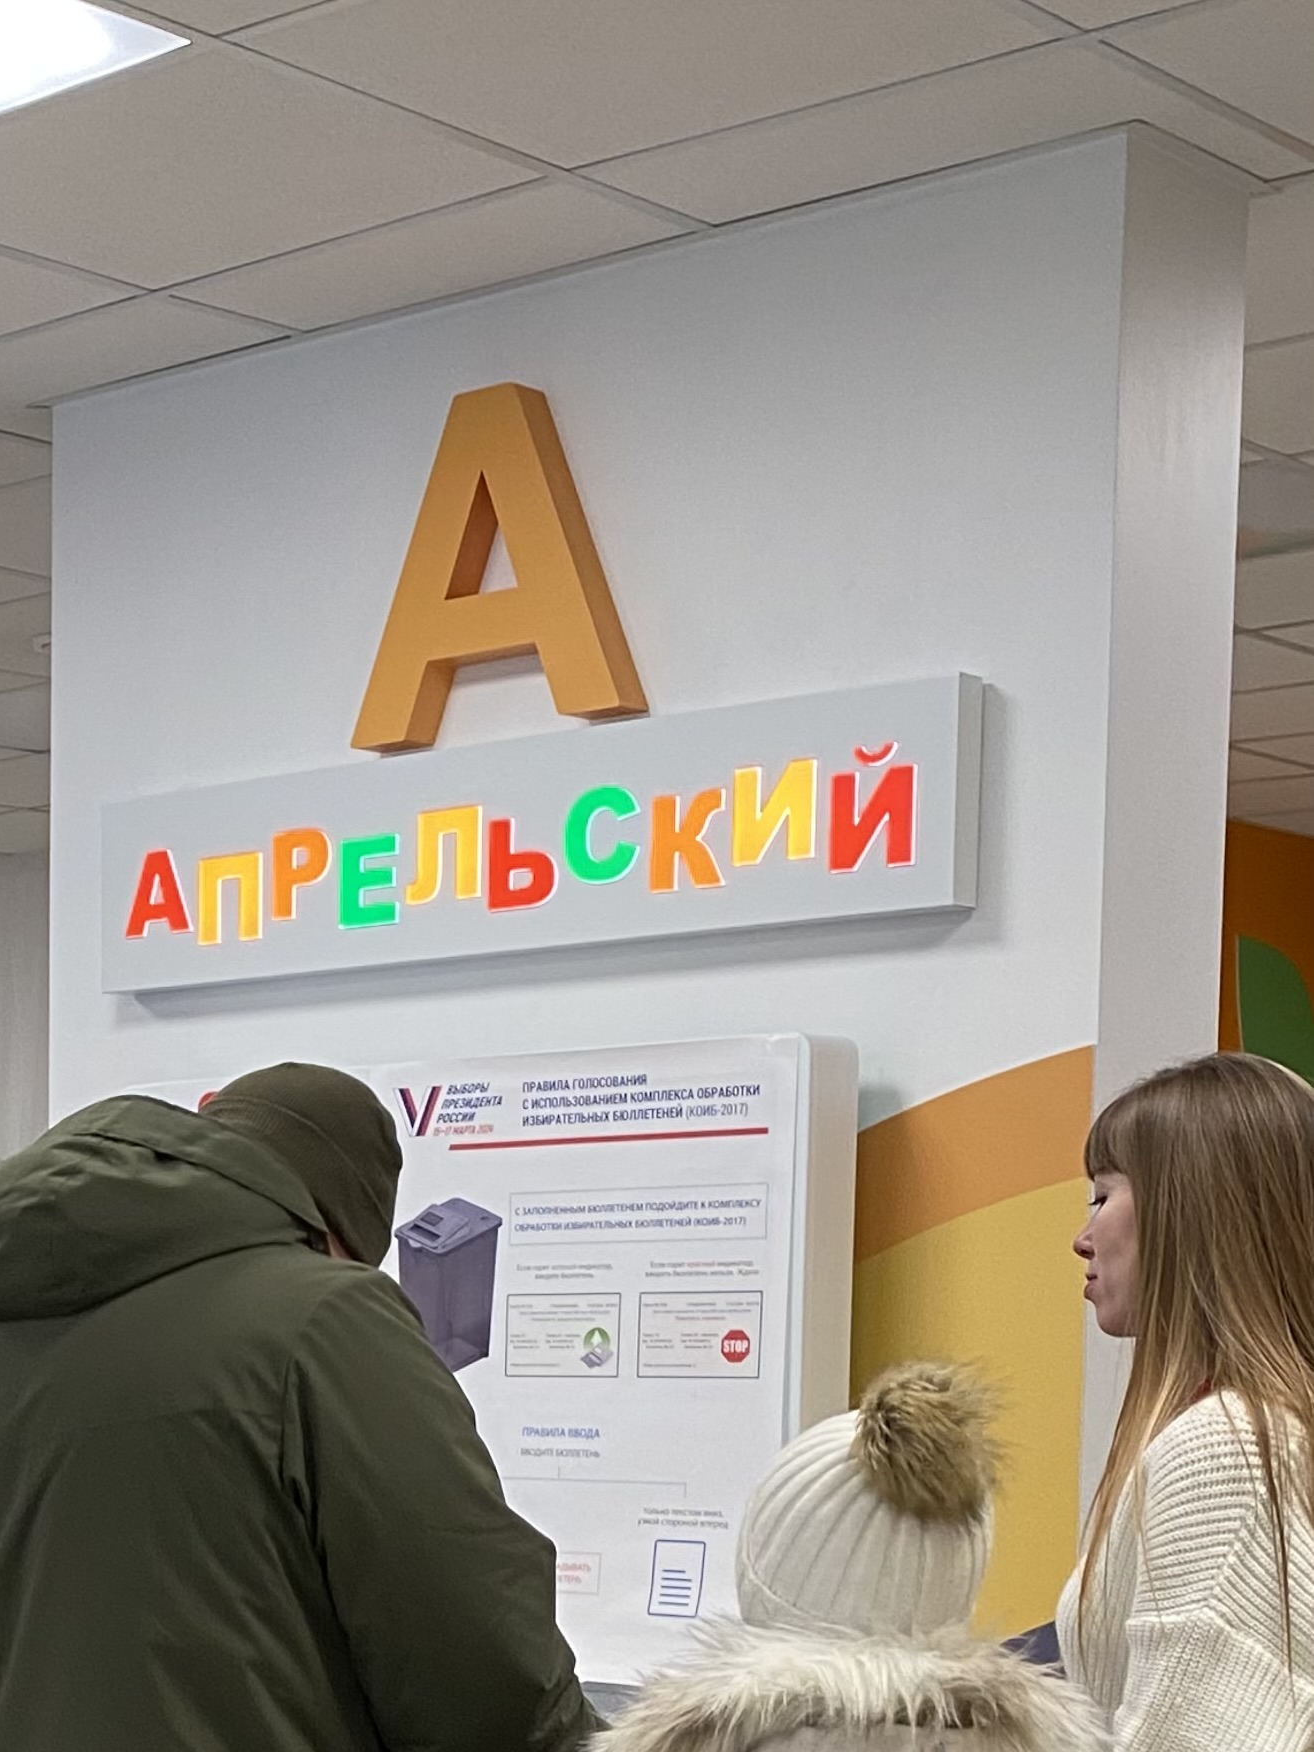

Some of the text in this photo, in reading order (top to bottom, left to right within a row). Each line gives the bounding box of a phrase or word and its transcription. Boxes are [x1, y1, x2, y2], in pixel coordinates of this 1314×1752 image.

[351, 381, 648, 753] А
[124, 742, 919, 947] АПРЕЛЬСКИЙ
[446, 1082, 490, 1095] ВЫБОРЫ
[522, 1073, 648, 1093] ПРАВИЛА ГОЛОСОВАНИЯ
[441, 1095, 503, 1110] ПРЕЗИДЕНТА
[522, 1083, 761, 1110] С ИСПОЛЬЗОВАНИЕМ КОМПЛЕКСА ОБРАБОТКИ
[436, 1111, 476, 1124] РОССИИ
[522, 1102, 749, 1127] ИЗБИРАТЕЛЬНЫХ БЮЛЛЕТЕНЕЙ (КОИБ-2017)
[522, 1205, 586, 1216] ЗАПОЛНЕННЫМ
[587, 1203, 643, 1214] БЮЛЛЕТЕНЕМ
[646, 1200, 699, 1212] ПОДОЙДИТЕ
[700, 1201, 706, 1210] К
[707, 1199, 762, 1209] КОМПЛЕКСУ
[514, 1216, 747, 1232] ОБРАБОТКИ ИЗБИРАТЕЛЬНЫХ БЮЛЛЕТЕНЕЙ (КОИБ-2017)
[723, 1340, 749, 1353] STOP
[522, 1426, 600, 1440] ПРАВИЛА ВВОДА
